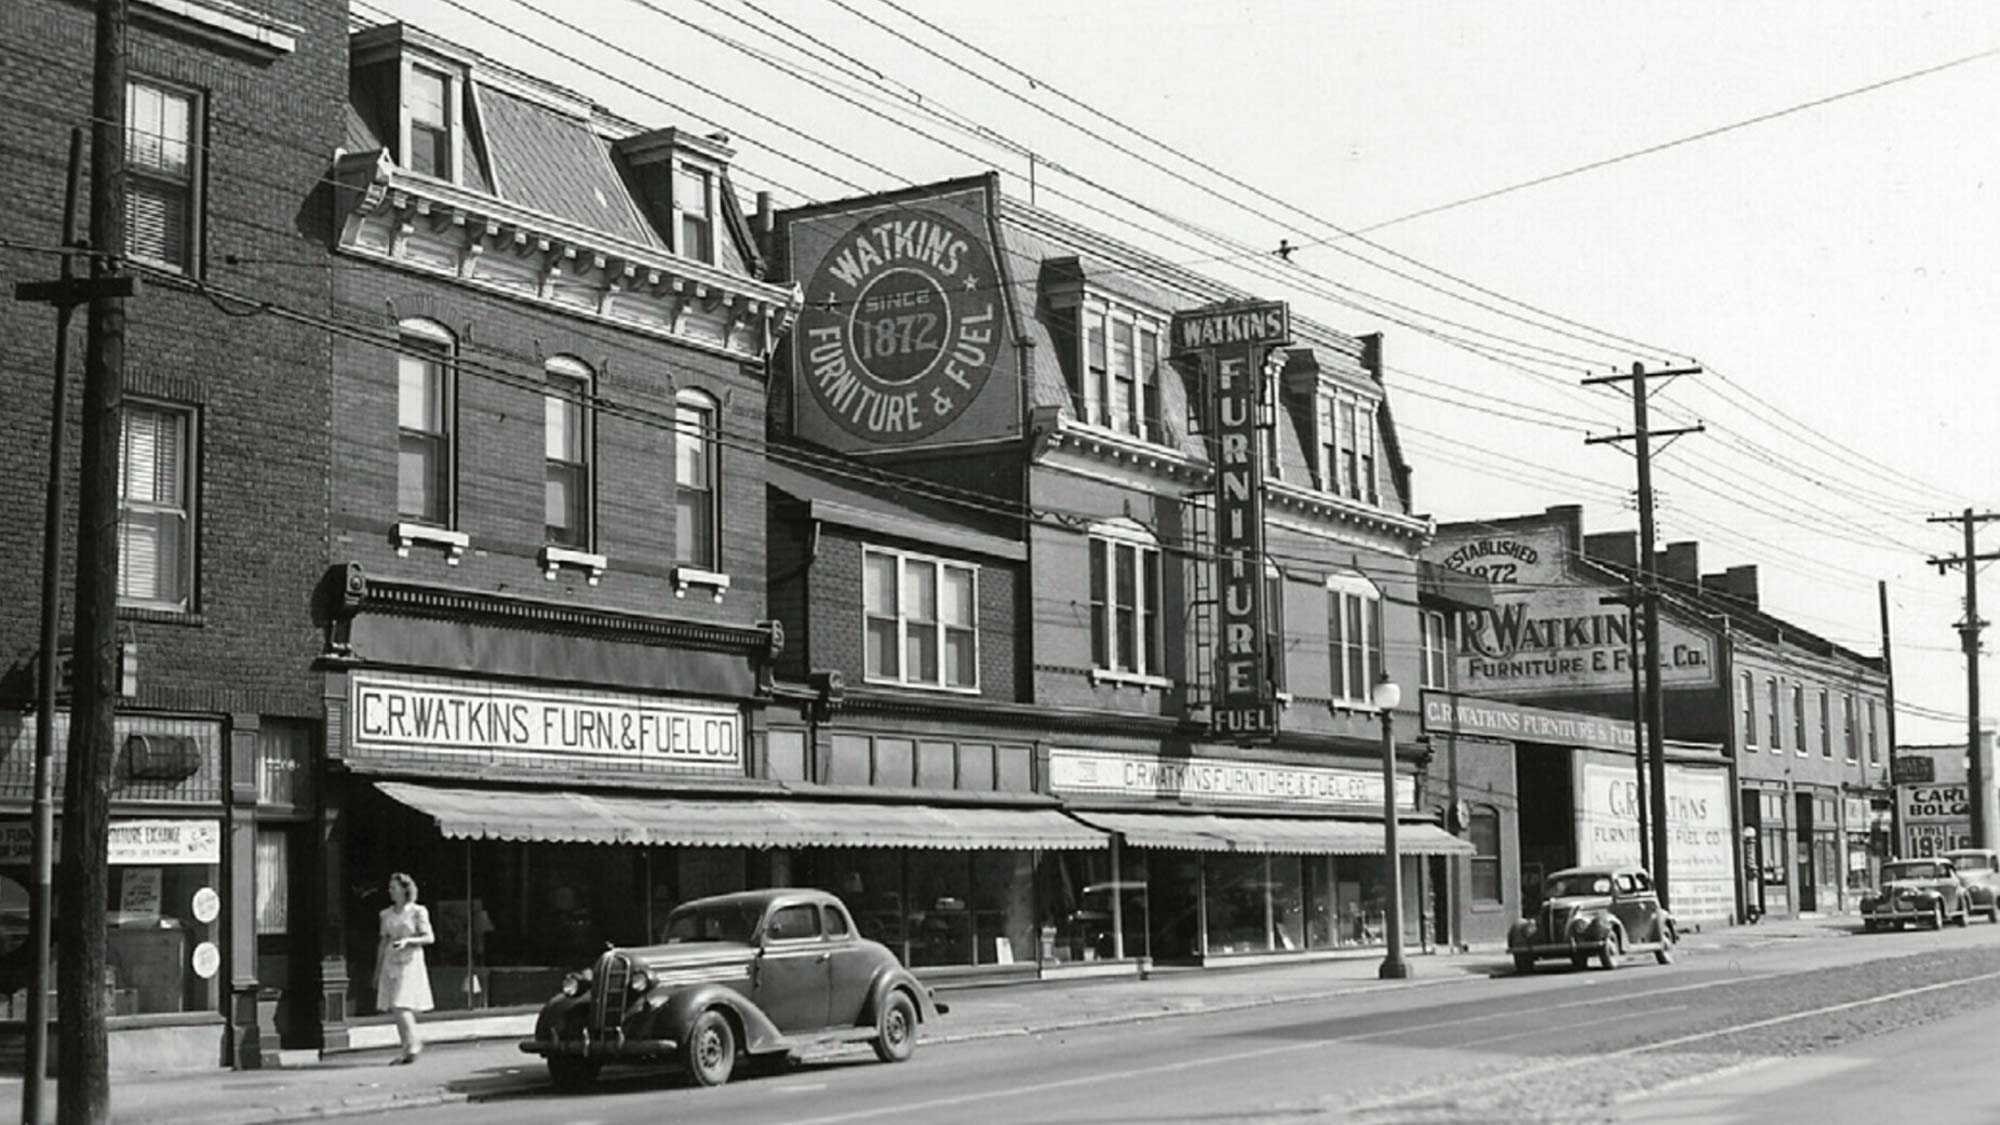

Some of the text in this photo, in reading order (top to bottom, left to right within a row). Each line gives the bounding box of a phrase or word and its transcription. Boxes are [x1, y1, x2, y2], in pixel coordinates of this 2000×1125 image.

[828, 220, 969, 288] WATKINS
[866, 288, 931, 313] SINCE
[863, 312, 940, 360] 1872
[1183, 309, 1281, 348] WATKINS
[808, 302, 994, 433] FURNITURE & FUEL
[1220, 358, 1254, 693] FURNITURE
[1444, 541, 1538, 571] ESTABLISHED
[1469, 658, 1584, 678] FURNITURE
[1215, 708, 1272, 732] FUEL
[1456, 706, 1520, 731] WATKINS
